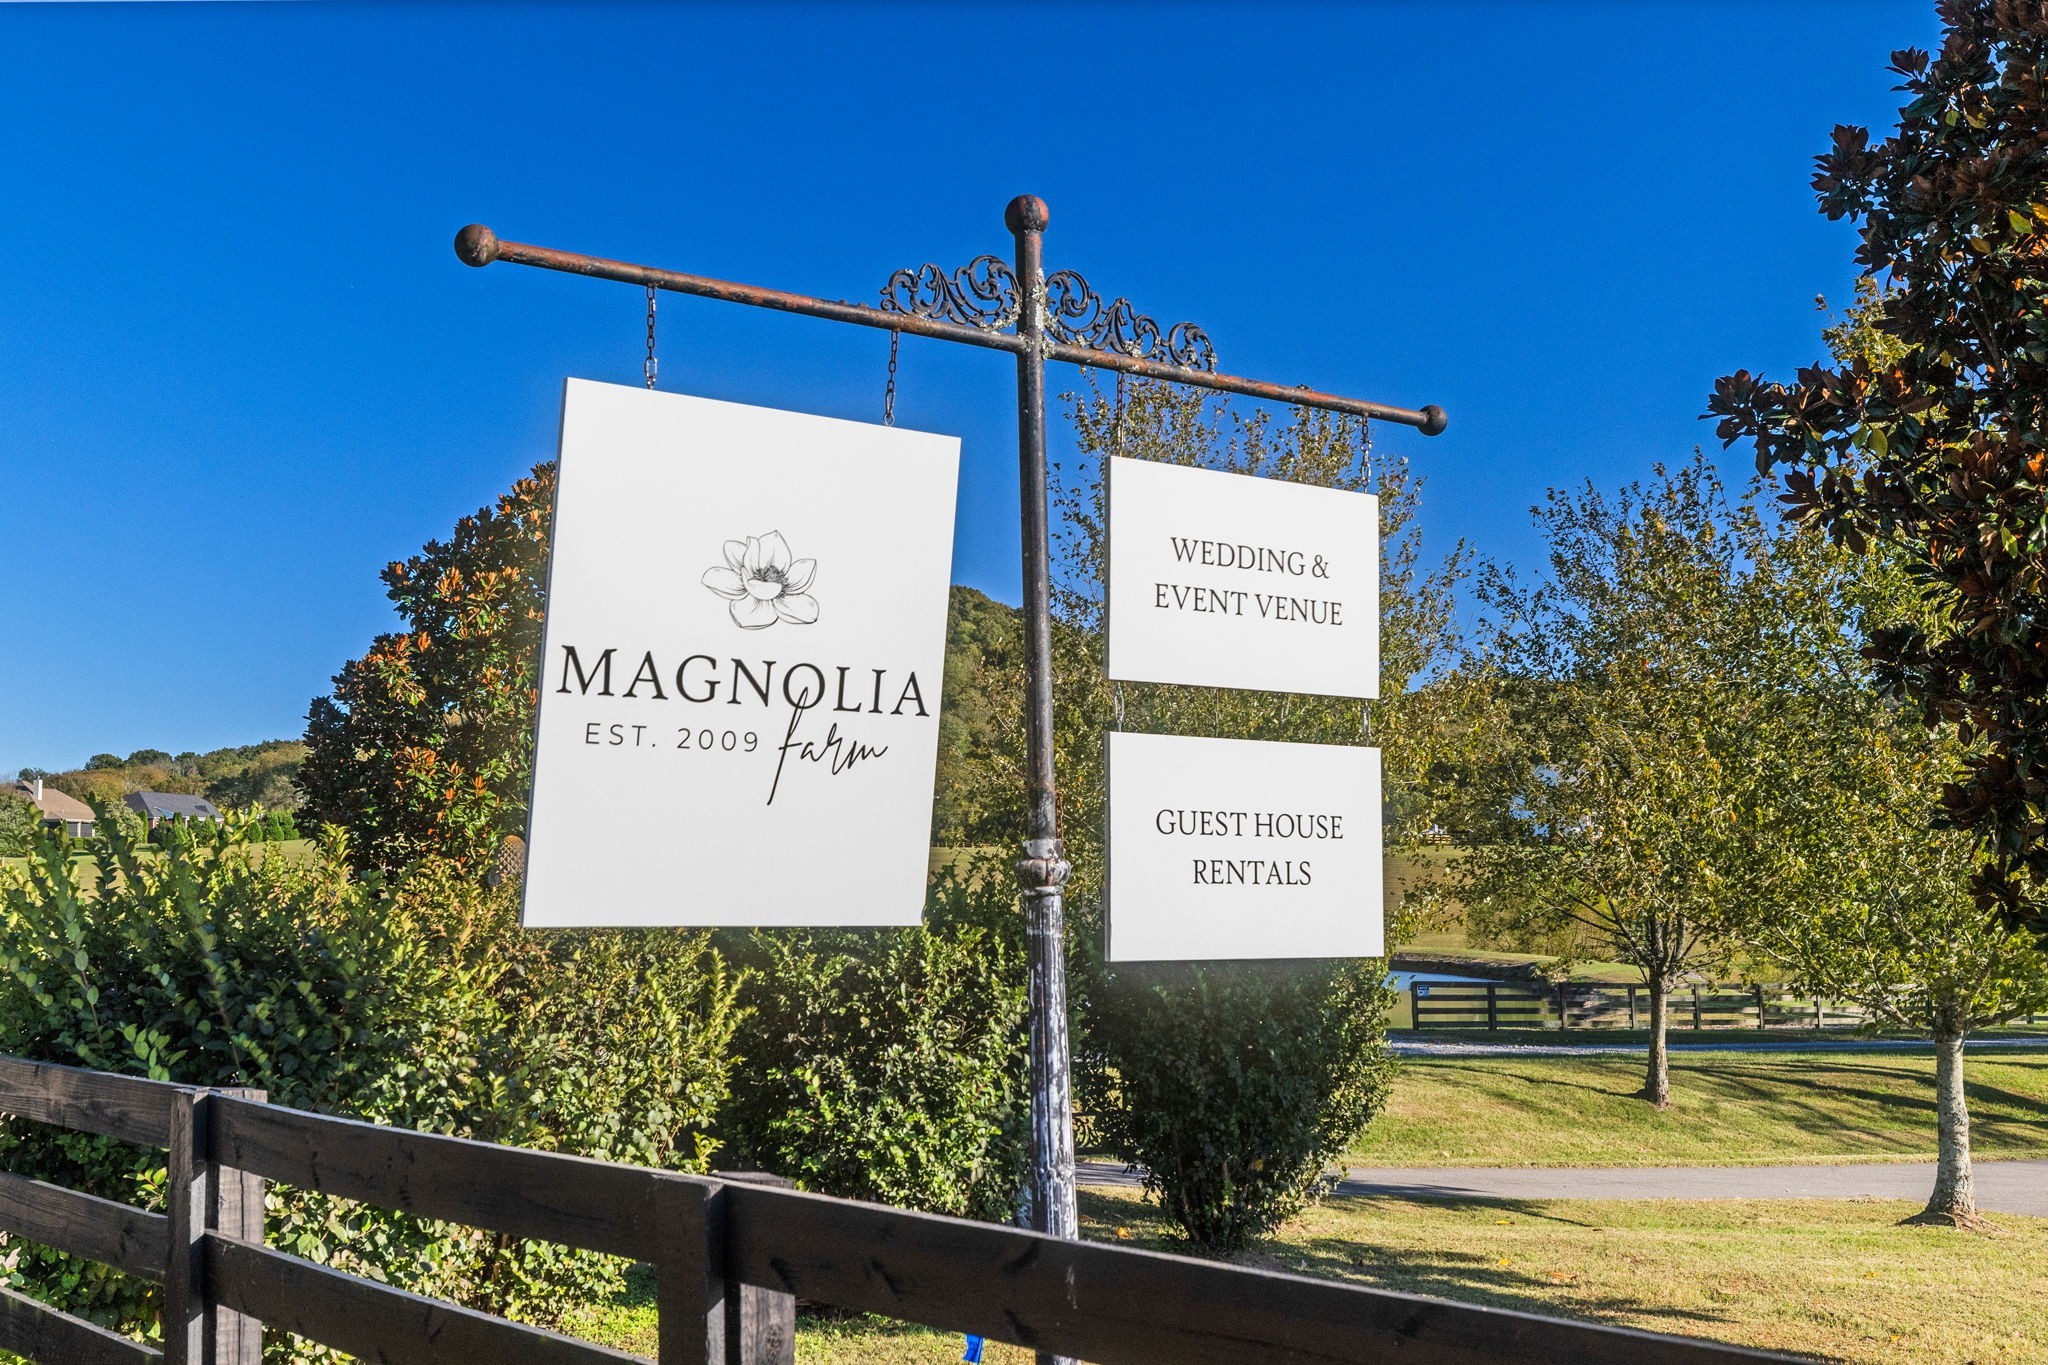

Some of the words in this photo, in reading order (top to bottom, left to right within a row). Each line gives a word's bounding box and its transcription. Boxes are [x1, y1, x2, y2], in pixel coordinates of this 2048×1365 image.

[1170, 536, 1306, 576] WEDDING
[1311, 554, 1330, 579] &
[1154, 583, 1248, 616] EVENT
[1254, 593, 1343, 626] VENUE
[556, 645, 931, 718] MAGNOLIA
[585, 722, 658, 748] EST.
[676, 727, 759, 753] 2009
[1155, 808, 1248, 837] GUEST
[1254, 812, 1344, 840] HOUSE
[1192, 859, 1312, 886] RENTALS
